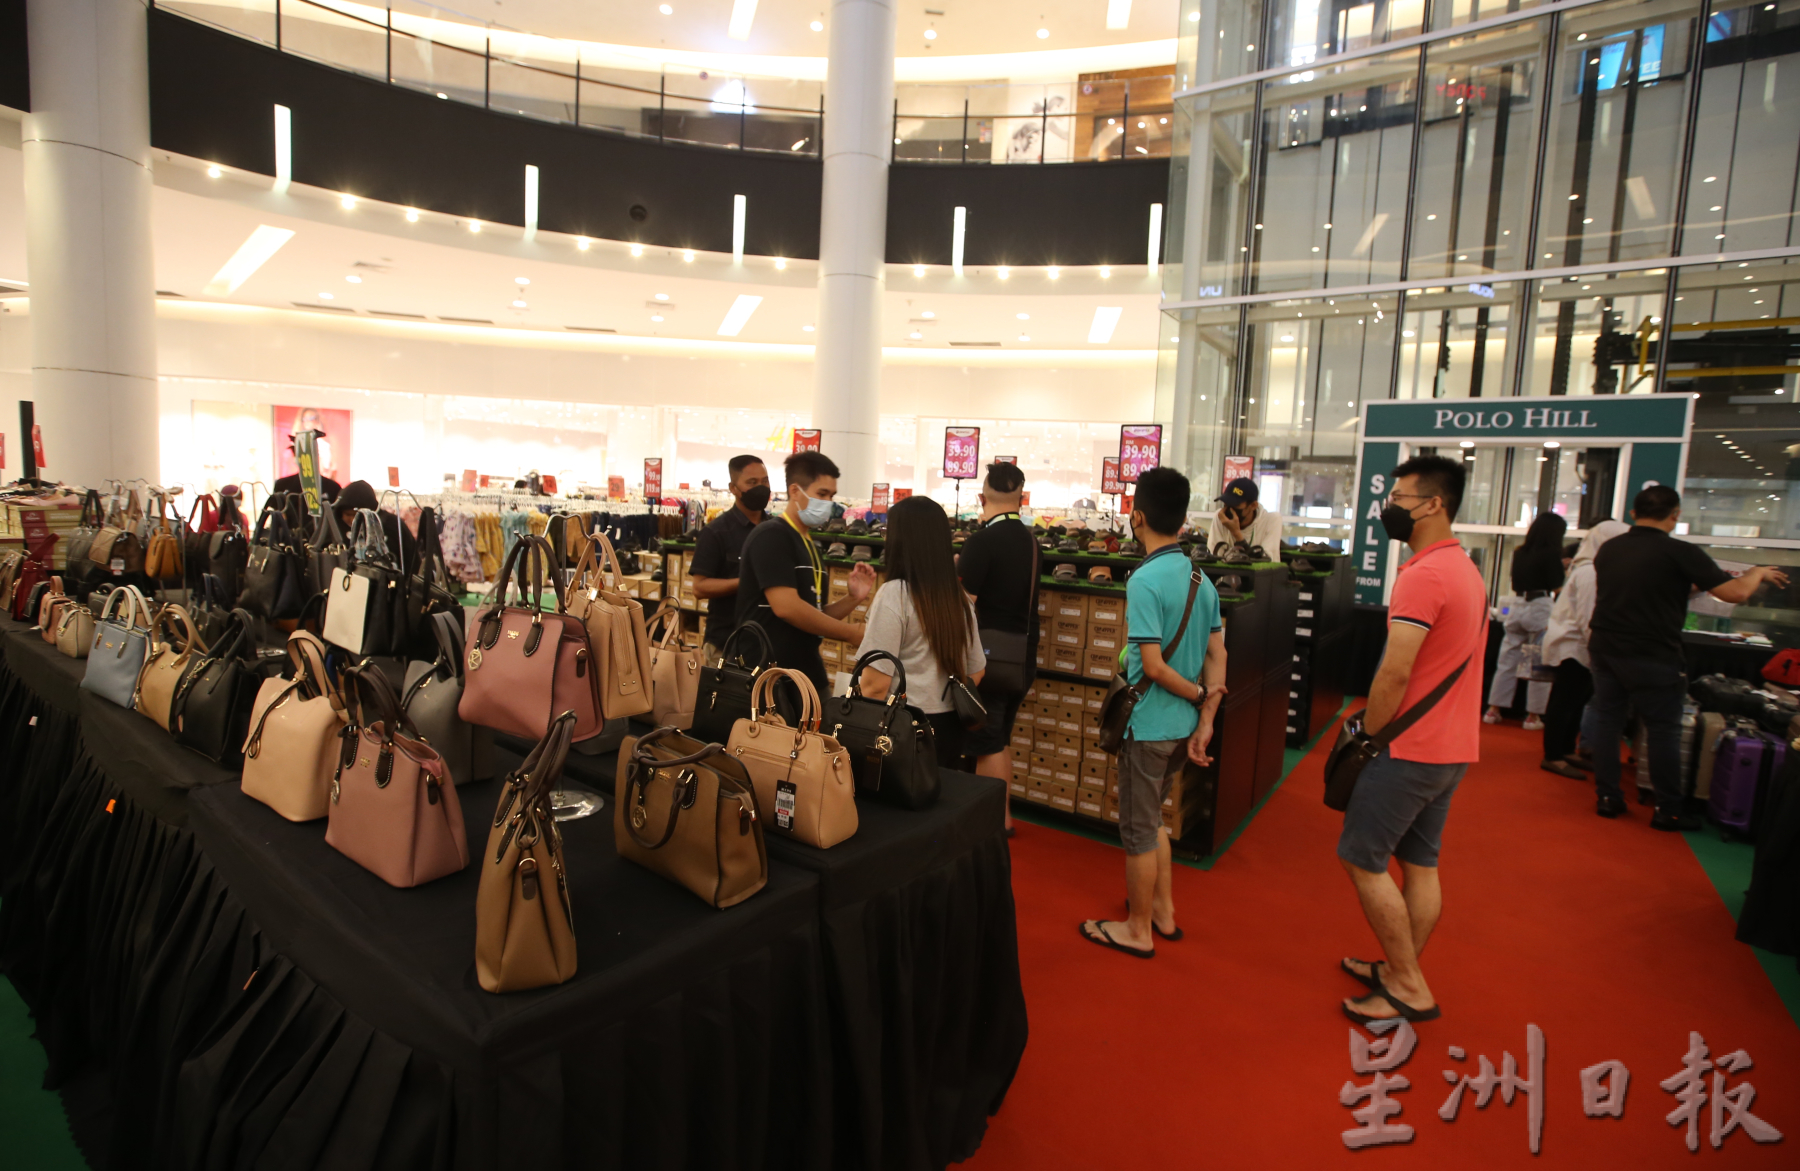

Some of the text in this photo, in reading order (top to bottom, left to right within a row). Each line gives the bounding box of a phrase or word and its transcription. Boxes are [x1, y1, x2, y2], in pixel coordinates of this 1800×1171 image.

[1433, 407, 1598, 429] POLO HILL
[948, 445, 976, 457] 39.90
[1124, 445, 1157, 459] 39.90
[946, 461, 975, 474] 89.90
[1362, 474, 1386, 571] SALE
[1355, 577, 1382, 587] FROM
